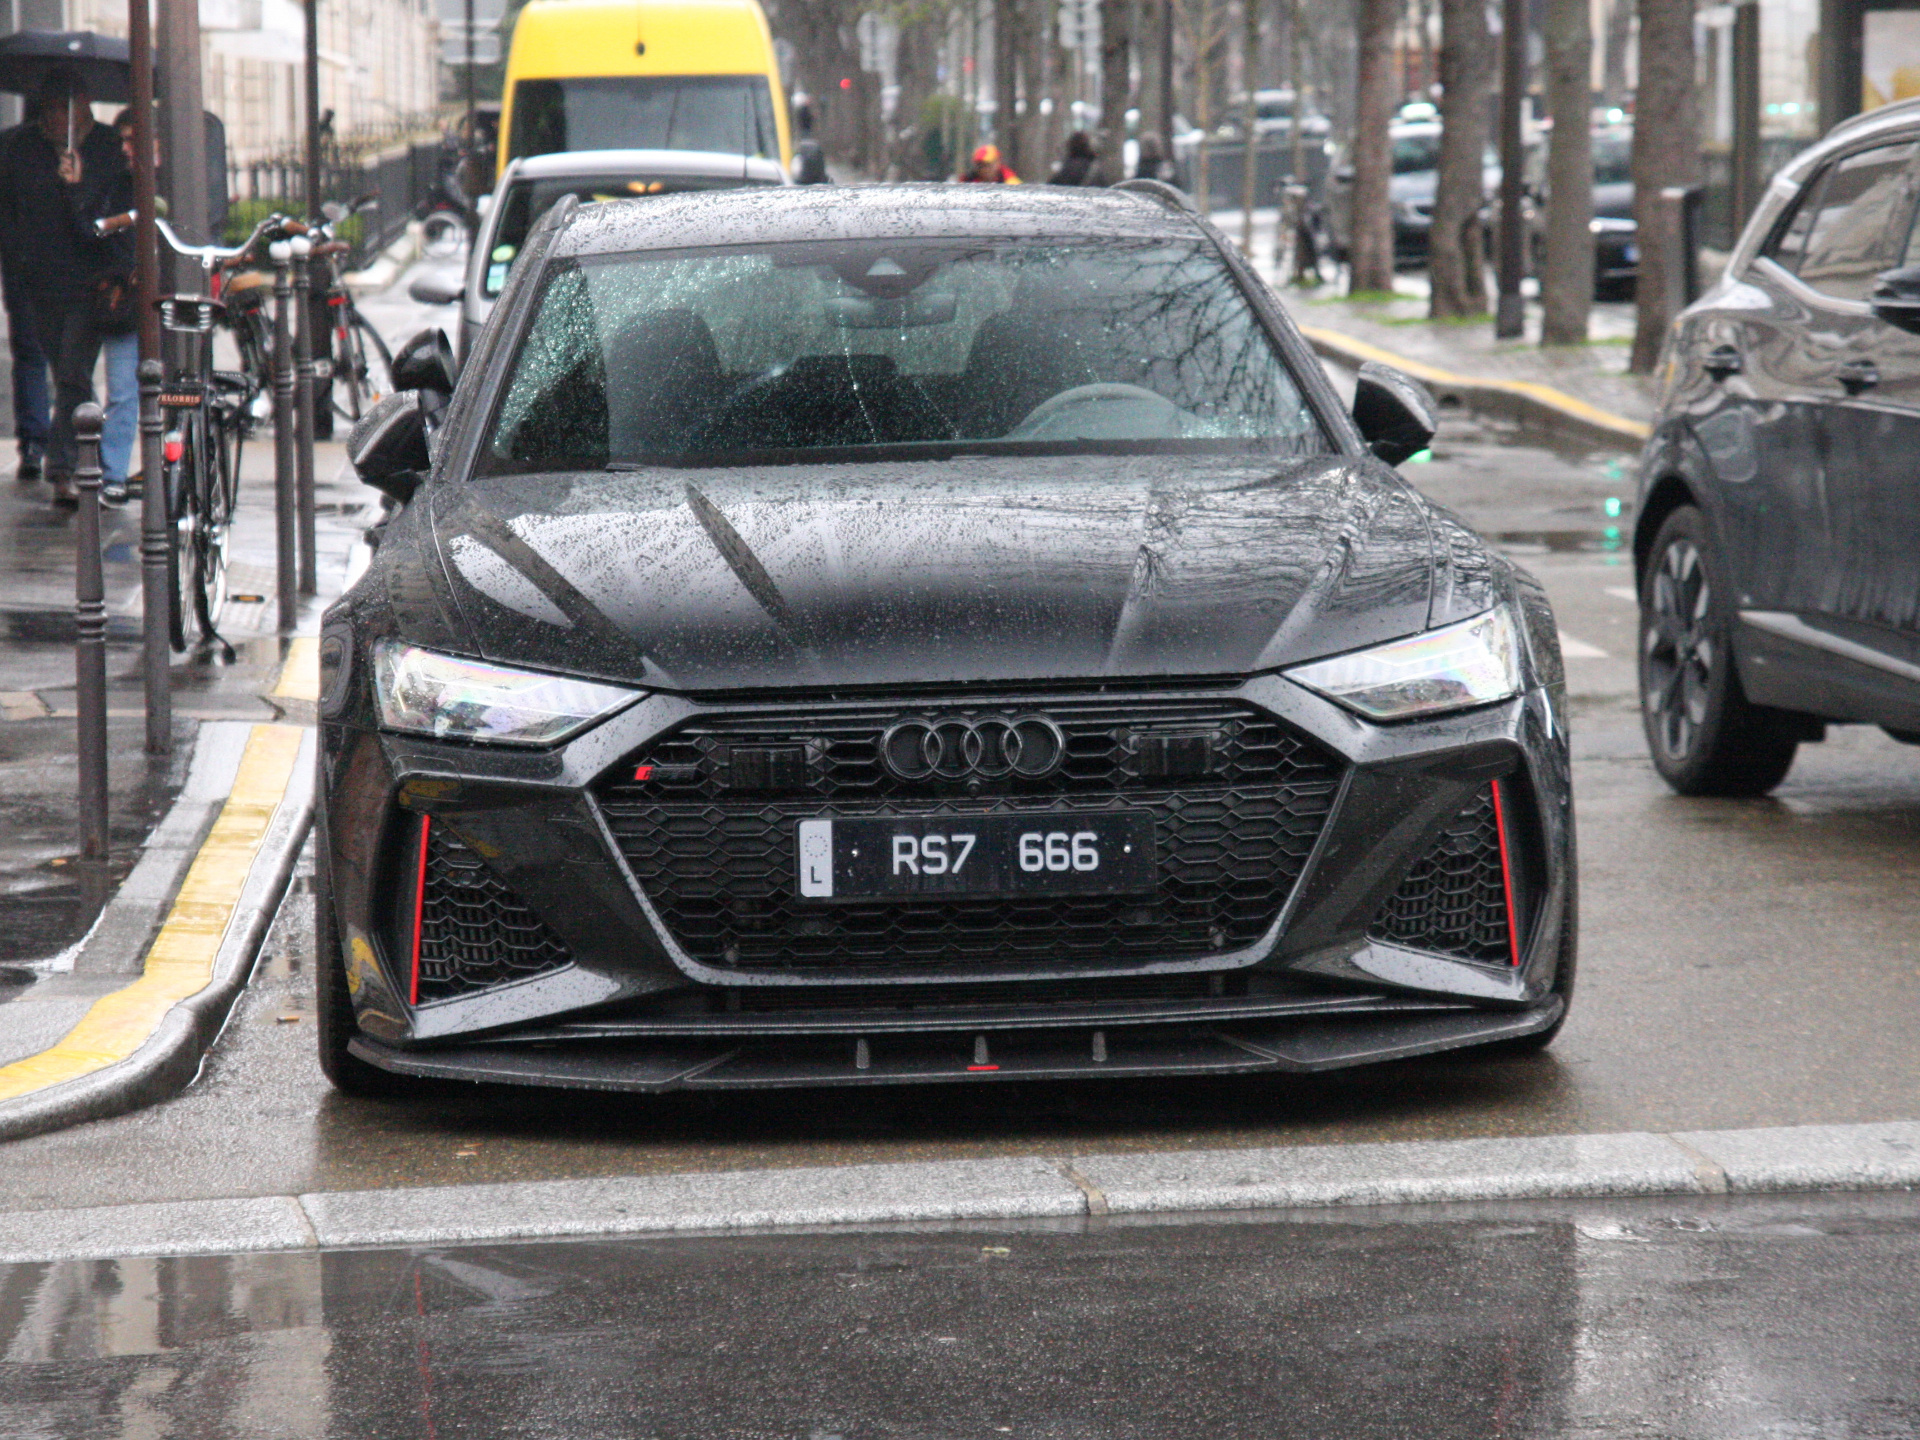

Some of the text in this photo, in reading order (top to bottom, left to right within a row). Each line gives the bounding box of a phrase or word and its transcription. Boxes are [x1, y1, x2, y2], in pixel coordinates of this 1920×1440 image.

[892, 832, 1099, 875] RS7 666
[810, 866, 823, 885] L
